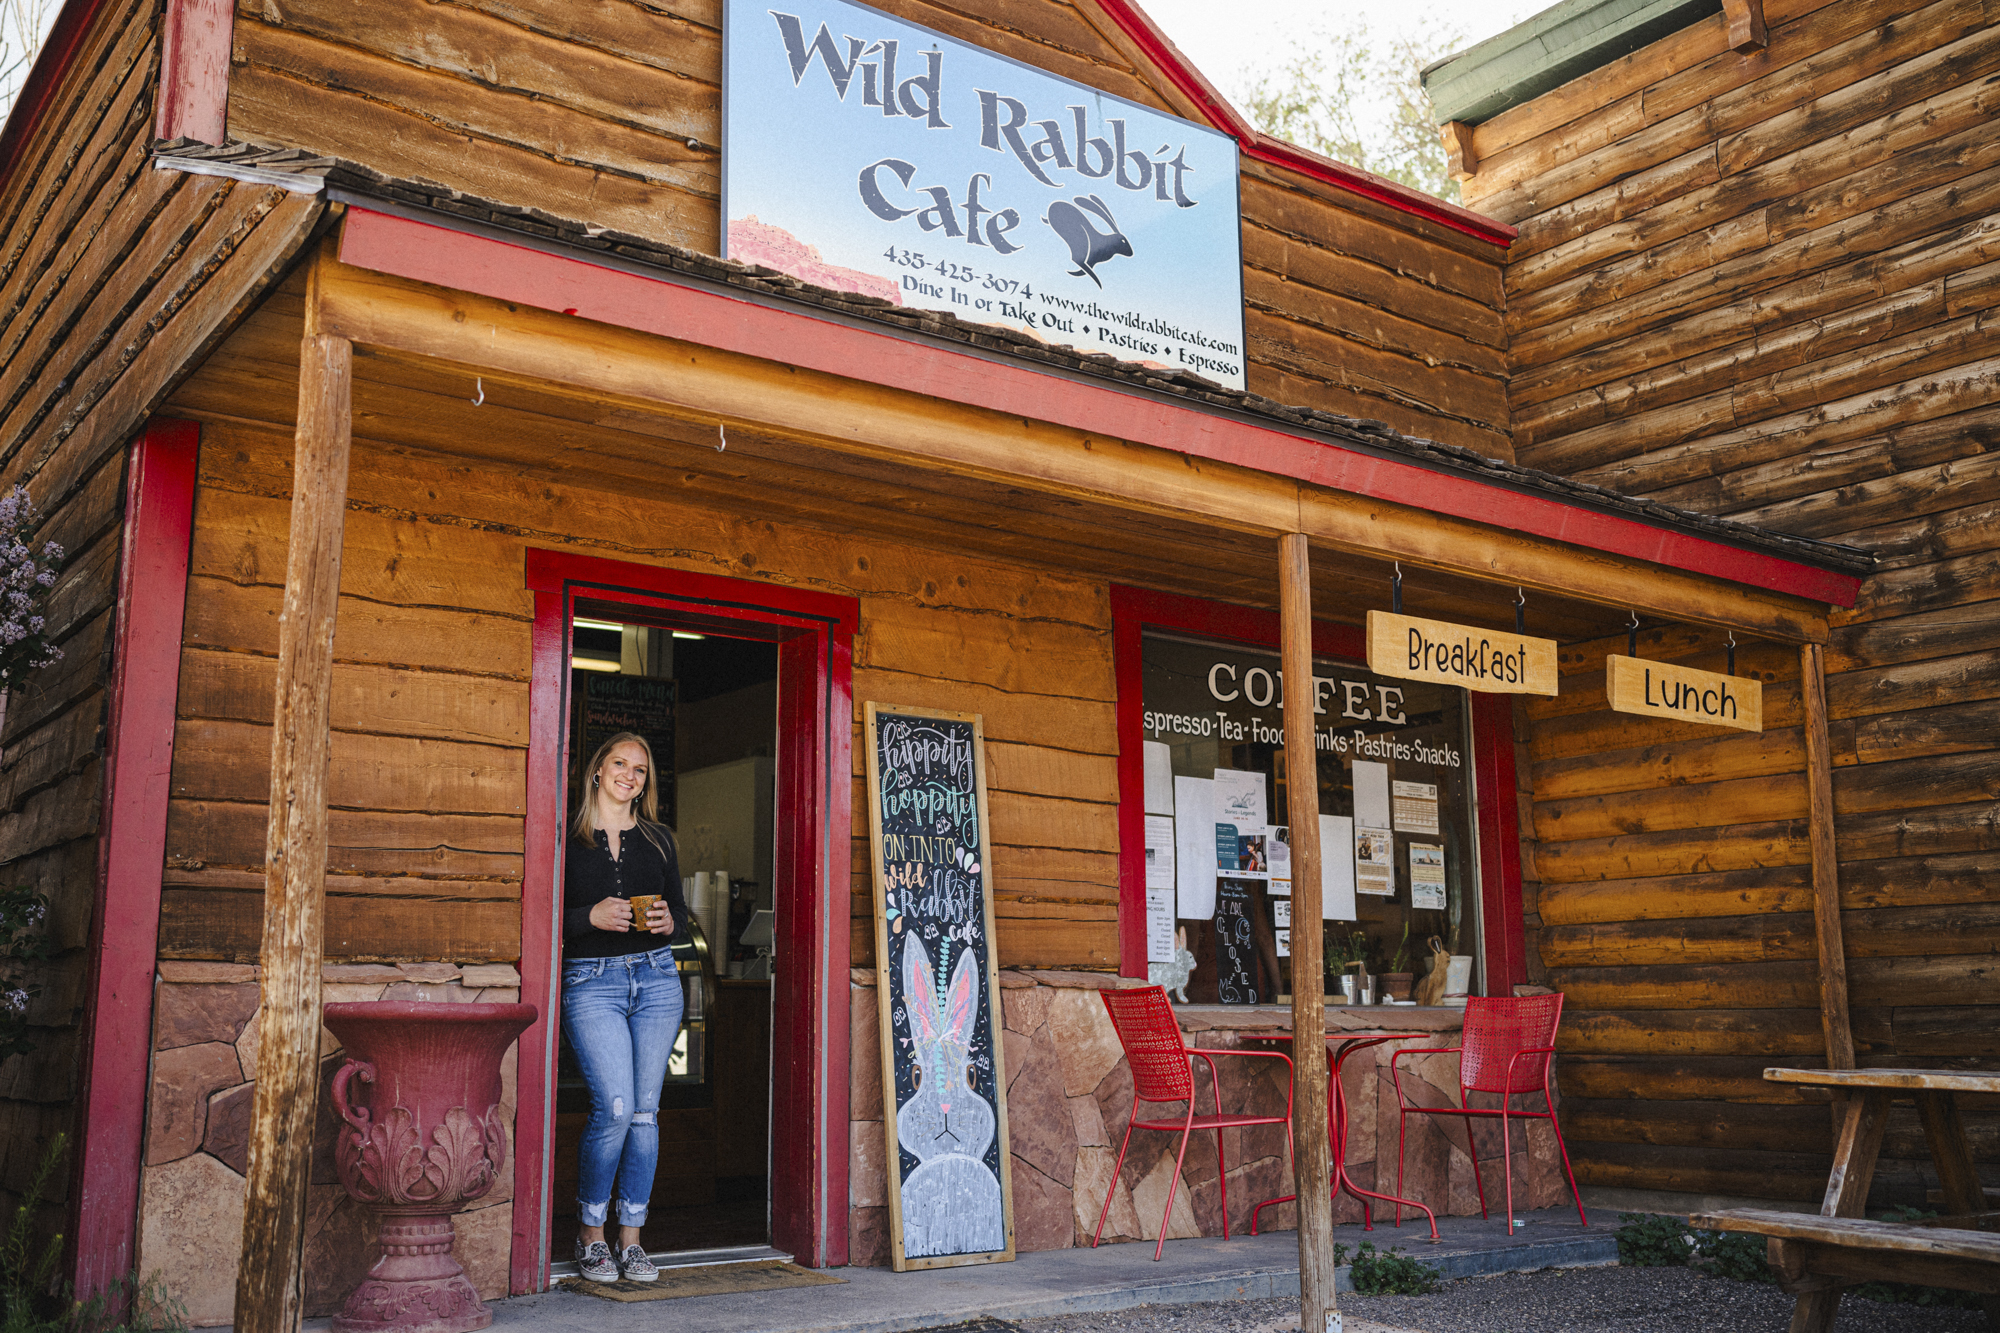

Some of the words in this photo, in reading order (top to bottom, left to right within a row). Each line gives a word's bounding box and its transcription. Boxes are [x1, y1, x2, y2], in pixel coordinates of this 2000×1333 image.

[768, 9, 952, 130] Wild
[973, 87, 1199, 208] Rabbit
[857, 157, 1025, 255] Cafe
[883, 245, 1033, 299] 435-425-3074
[1040, 293, 1238, 355] www.thewildrabbitcafe.com
[902, 274, 943, 298] Dine
[950, 287, 969, 306] In
[974, 298, 993, 312] or
[999, 300, 1039, 329] Take
[1042, 312, 1075, 333] Out
[1098, 326, 1158, 355] Pastries
[1178, 347, 1239, 376] Espresso
[1408, 627, 1526, 684] Breakfast
[1207, 662, 1407, 725] COFEE
[1645, 668, 1737, 720] Lunch
[880, 767, 978, 849] hoppity
[883, 833, 906, 861] ON
[898, 869, 981, 923] Rabbit
[1229, 901, 1244, 917] ARE
